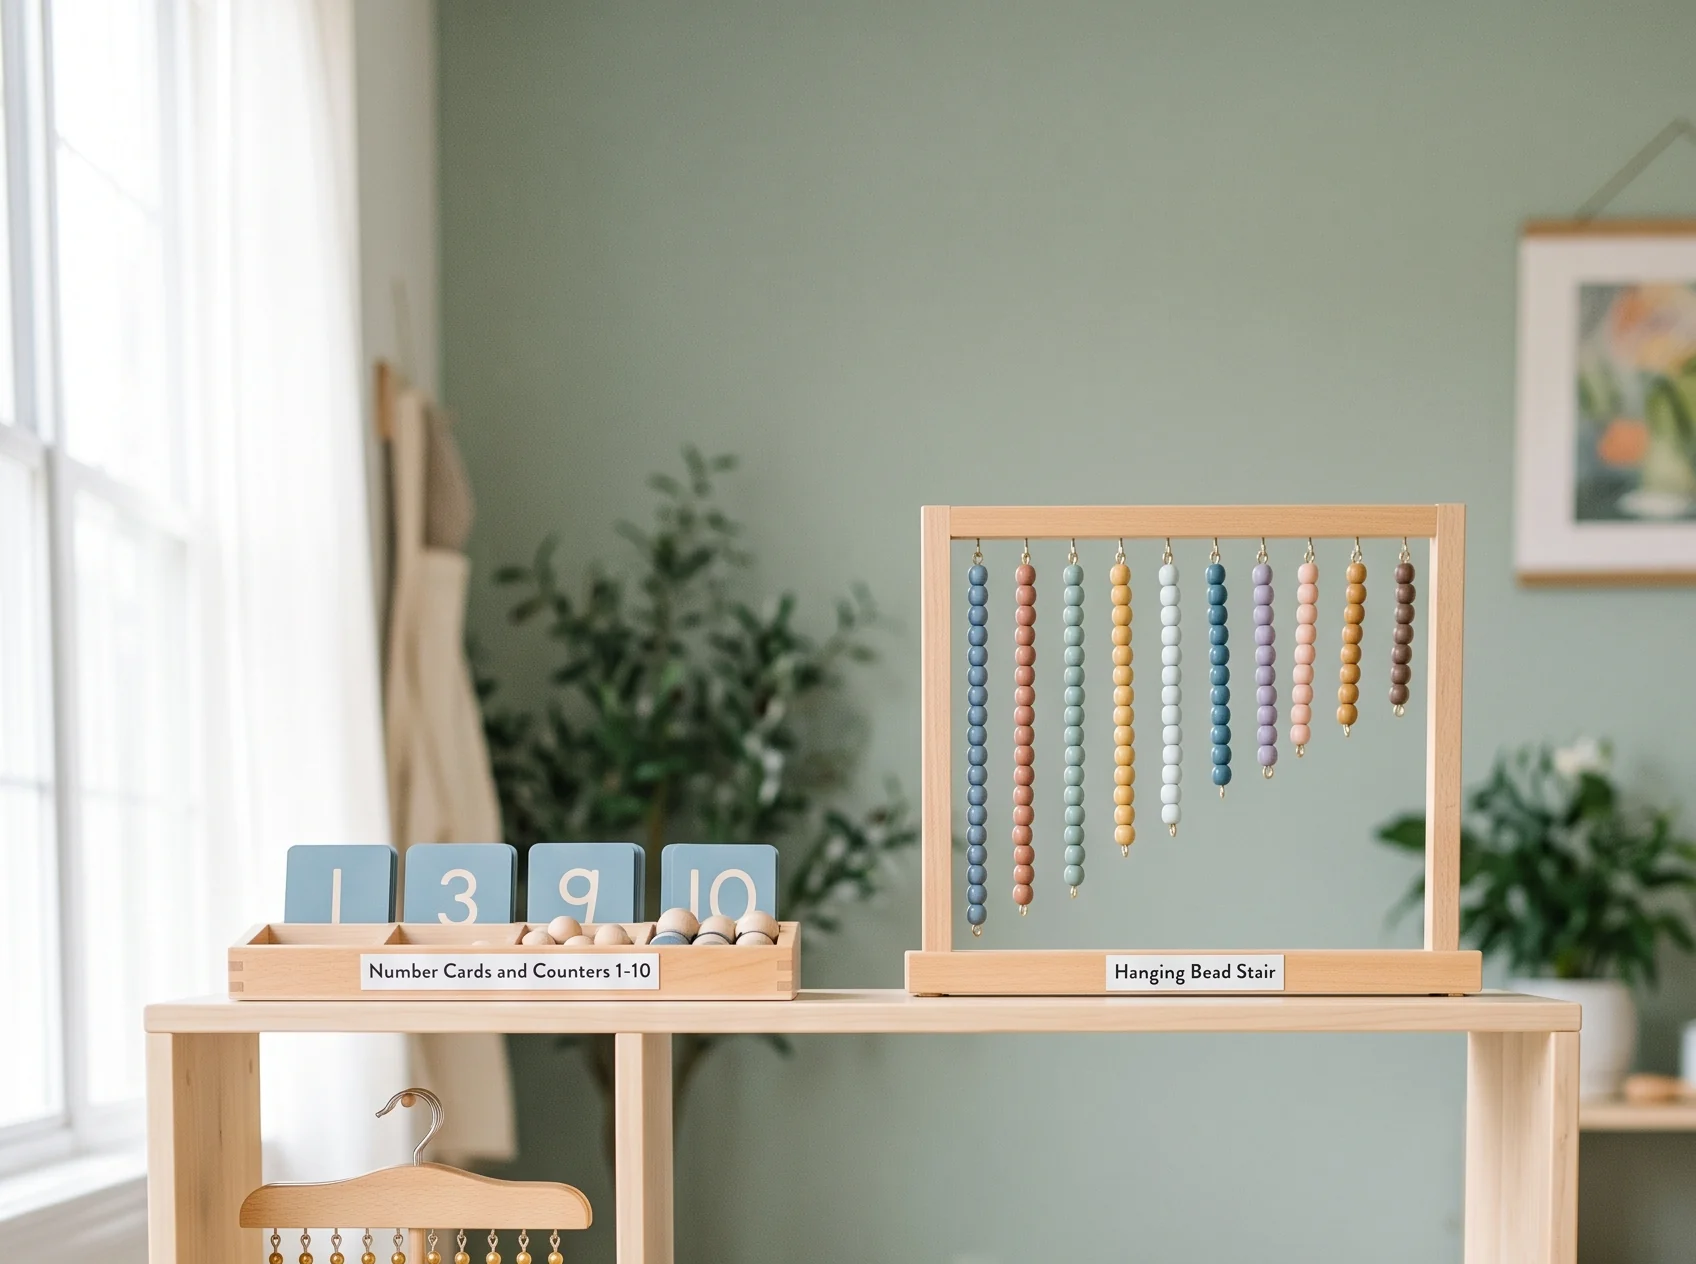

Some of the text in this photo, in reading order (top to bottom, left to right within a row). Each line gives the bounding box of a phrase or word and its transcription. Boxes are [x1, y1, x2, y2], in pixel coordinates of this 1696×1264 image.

[332, 867, 341, 923] 1
[437, 867, 479, 924] 3
[558, 867, 600, 923] 9
[690, 867, 758, 918] 10
[369, 962, 439, 979] Number
[443, 962, 492, 979] Cards
[497, 962, 527, 979] and
[532, 962, 611, 979] Counters
[1115, 963, 1276, 986] Hanging Bead Stair
